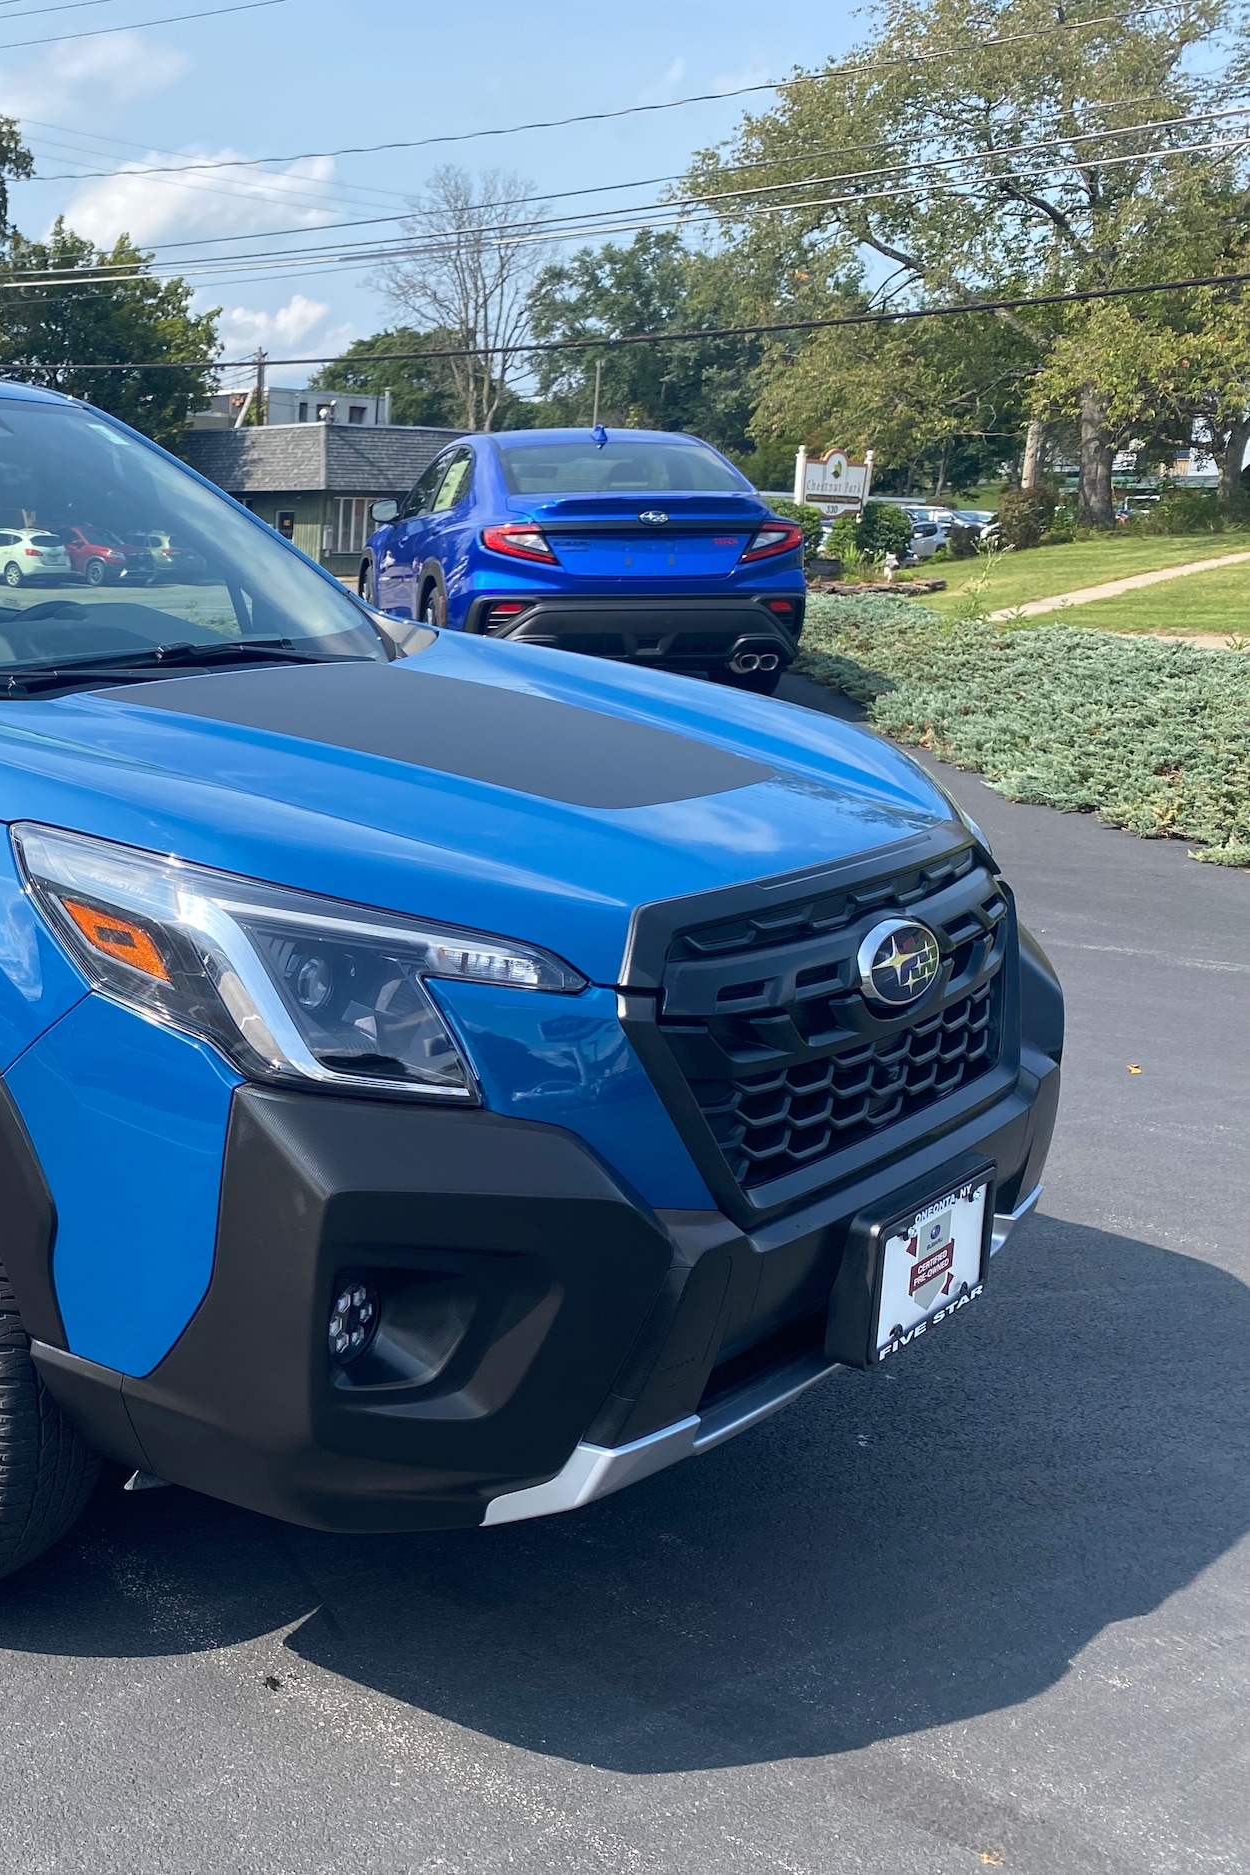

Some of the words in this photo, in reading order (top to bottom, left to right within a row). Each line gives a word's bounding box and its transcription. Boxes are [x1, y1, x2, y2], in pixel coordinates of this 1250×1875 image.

[806, 479, 842, 492] Chestnut
[844, 482, 861, 494] Park
[826, 505, 838, 514] 330
[89, 872, 145, 895] FORESTER
[958, 1183, 973, 1199] NY
[926, 1237, 944, 1251] SUBARU
[917, 1249, 948, 1275] CERTIFIED
[913, 1258, 950, 1287] PRE-OWNED
[878, 1322, 928, 1362] FIVE
[932, 1284, 984, 1325] STAR
